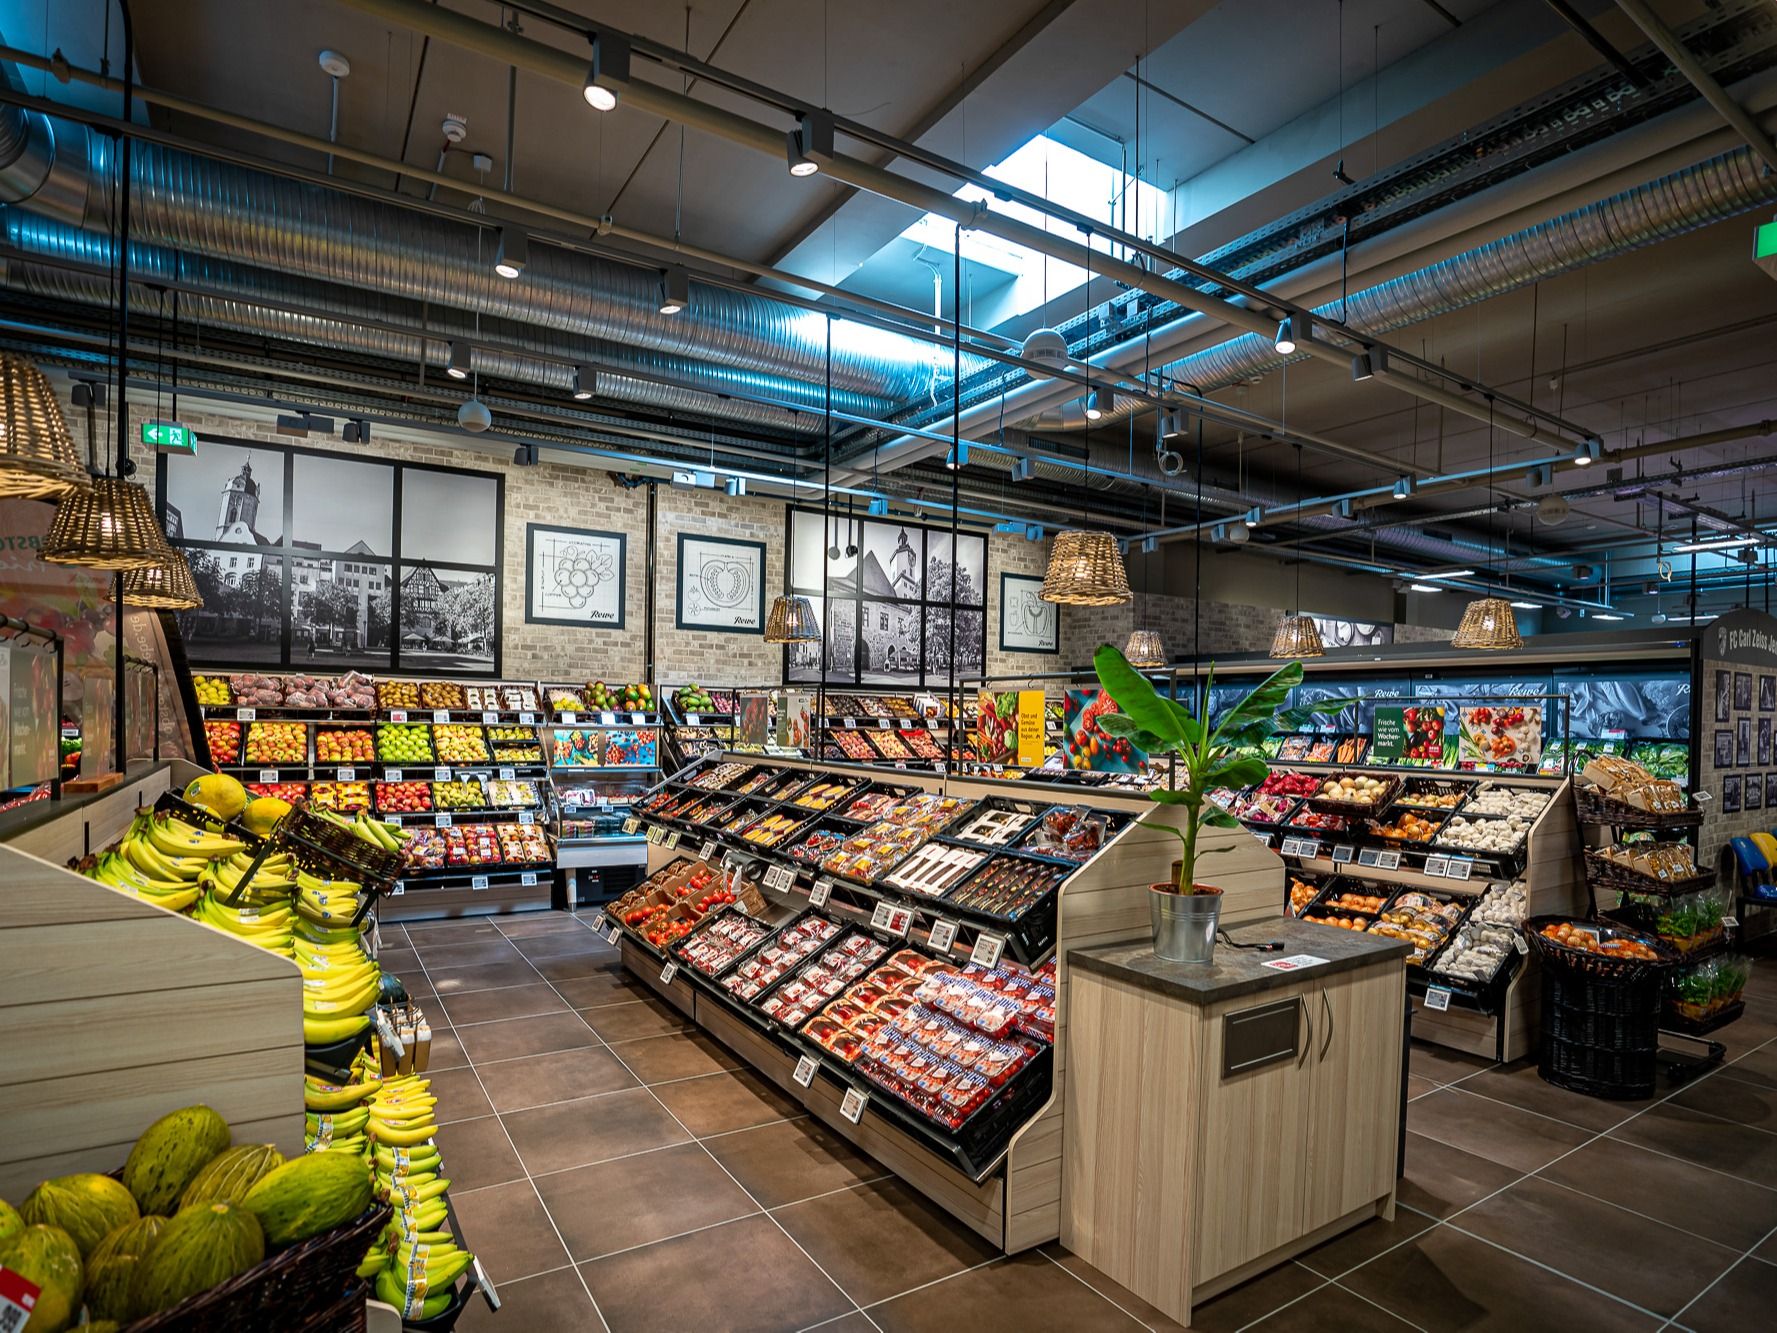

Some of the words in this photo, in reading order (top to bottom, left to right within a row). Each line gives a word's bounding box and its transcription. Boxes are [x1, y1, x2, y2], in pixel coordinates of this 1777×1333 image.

[590, 609, 614, 619] Rewe
[733, 615, 756, 625] Rewe
[1729, 630, 1738, 650] FC
[1738, 628, 1751, 648] Carl
[1752, 629, 1768, 650] Zeiss
[1374, 688, 1400, 698] Rewe
[1508, 686, 1540, 697] Rewe
[1377, 719, 1396, 727] Frische
[1377, 733, 1401, 741] Wochen-
